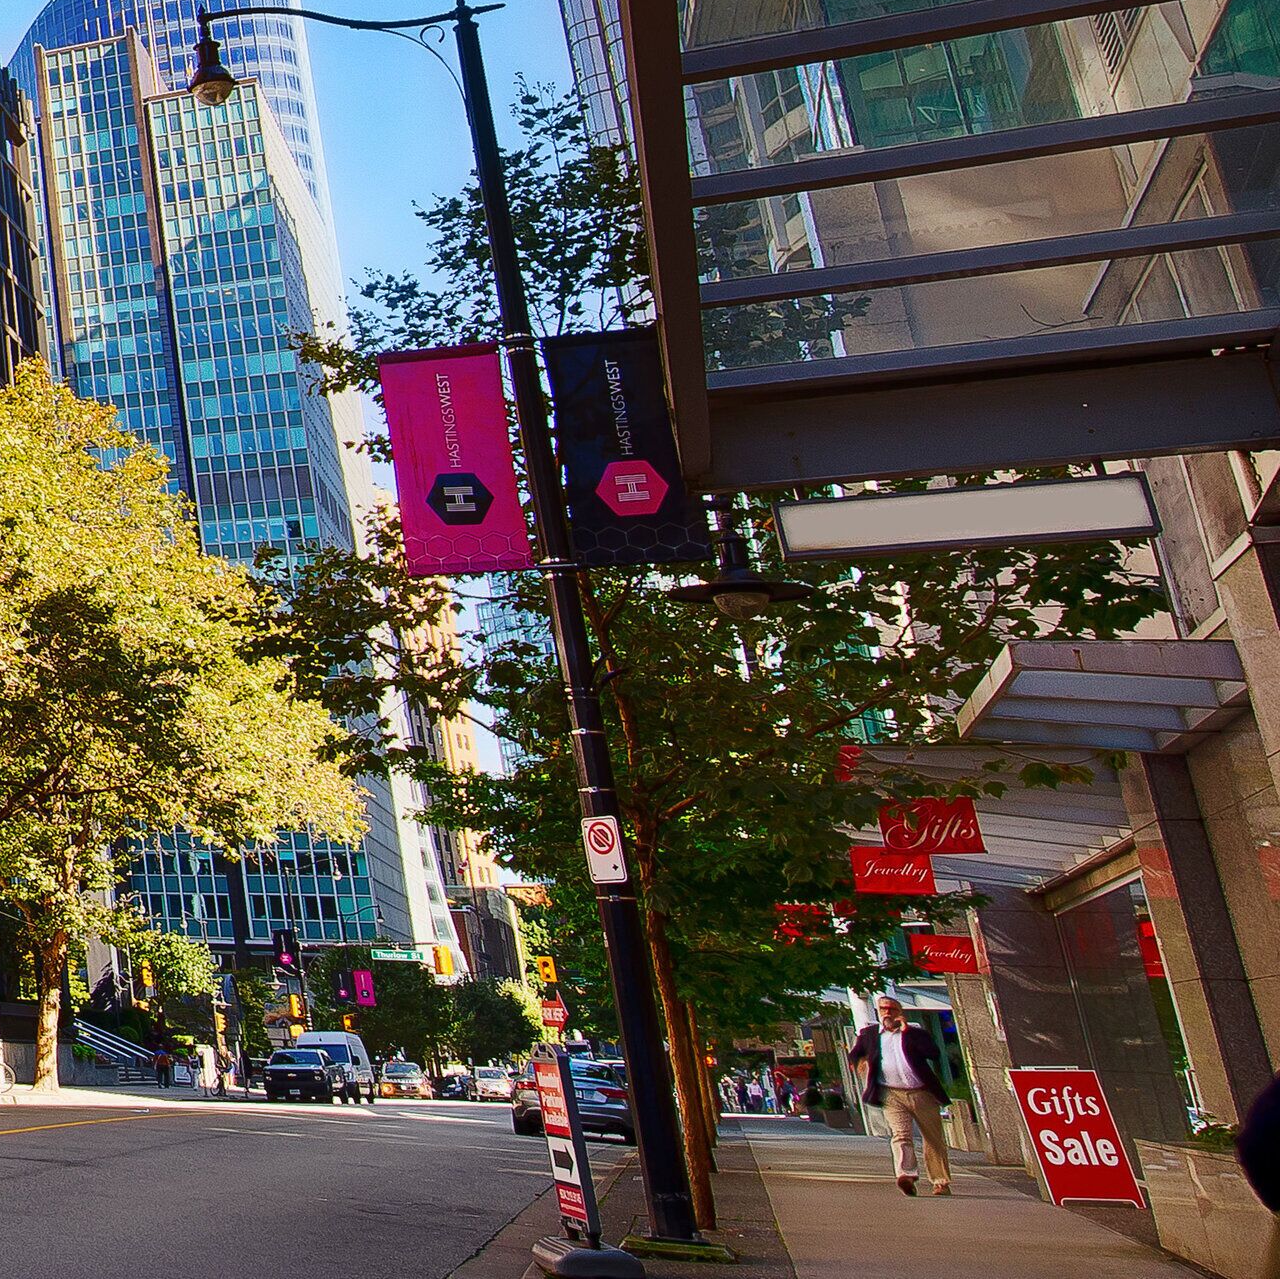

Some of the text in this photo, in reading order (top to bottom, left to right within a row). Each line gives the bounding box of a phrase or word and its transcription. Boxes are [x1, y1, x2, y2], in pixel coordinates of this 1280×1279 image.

[885, 802, 977, 852] Gifts
[377, 951, 408, 959] Thurlow
[1027, 1086, 1100, 1124] Gifts
[1039, 1129, 1119, 1166] Sale
